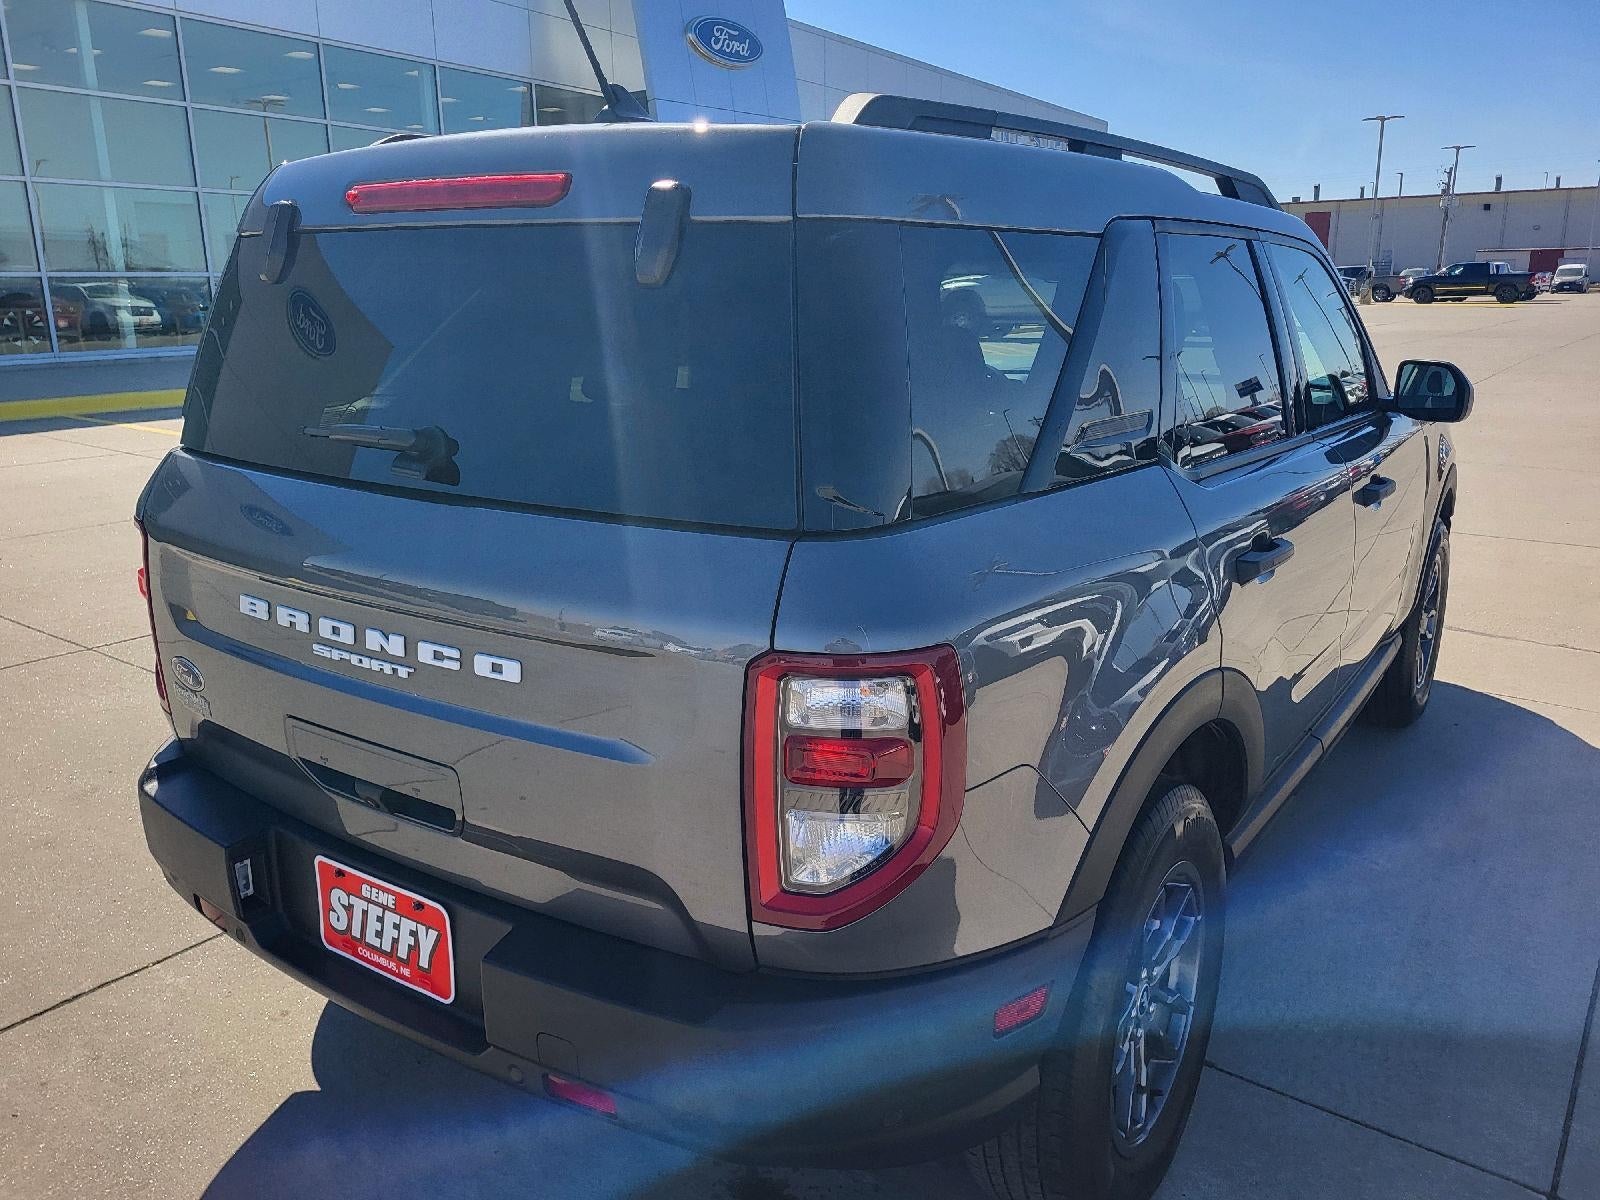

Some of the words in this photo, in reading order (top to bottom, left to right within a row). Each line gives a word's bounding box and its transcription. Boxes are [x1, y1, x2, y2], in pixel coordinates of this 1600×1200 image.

[710, 25, 751, 57] Ford
[239, 594, 522, 684] BRONCO
[312, 643, 415, 679] SPORT
[361, 883, 396, 909] GENE
[329, 888, 440, 970] STEFFY
[357, 946, 399, 974] COLUMBUS,
[399, 967, 411, 978] NE
